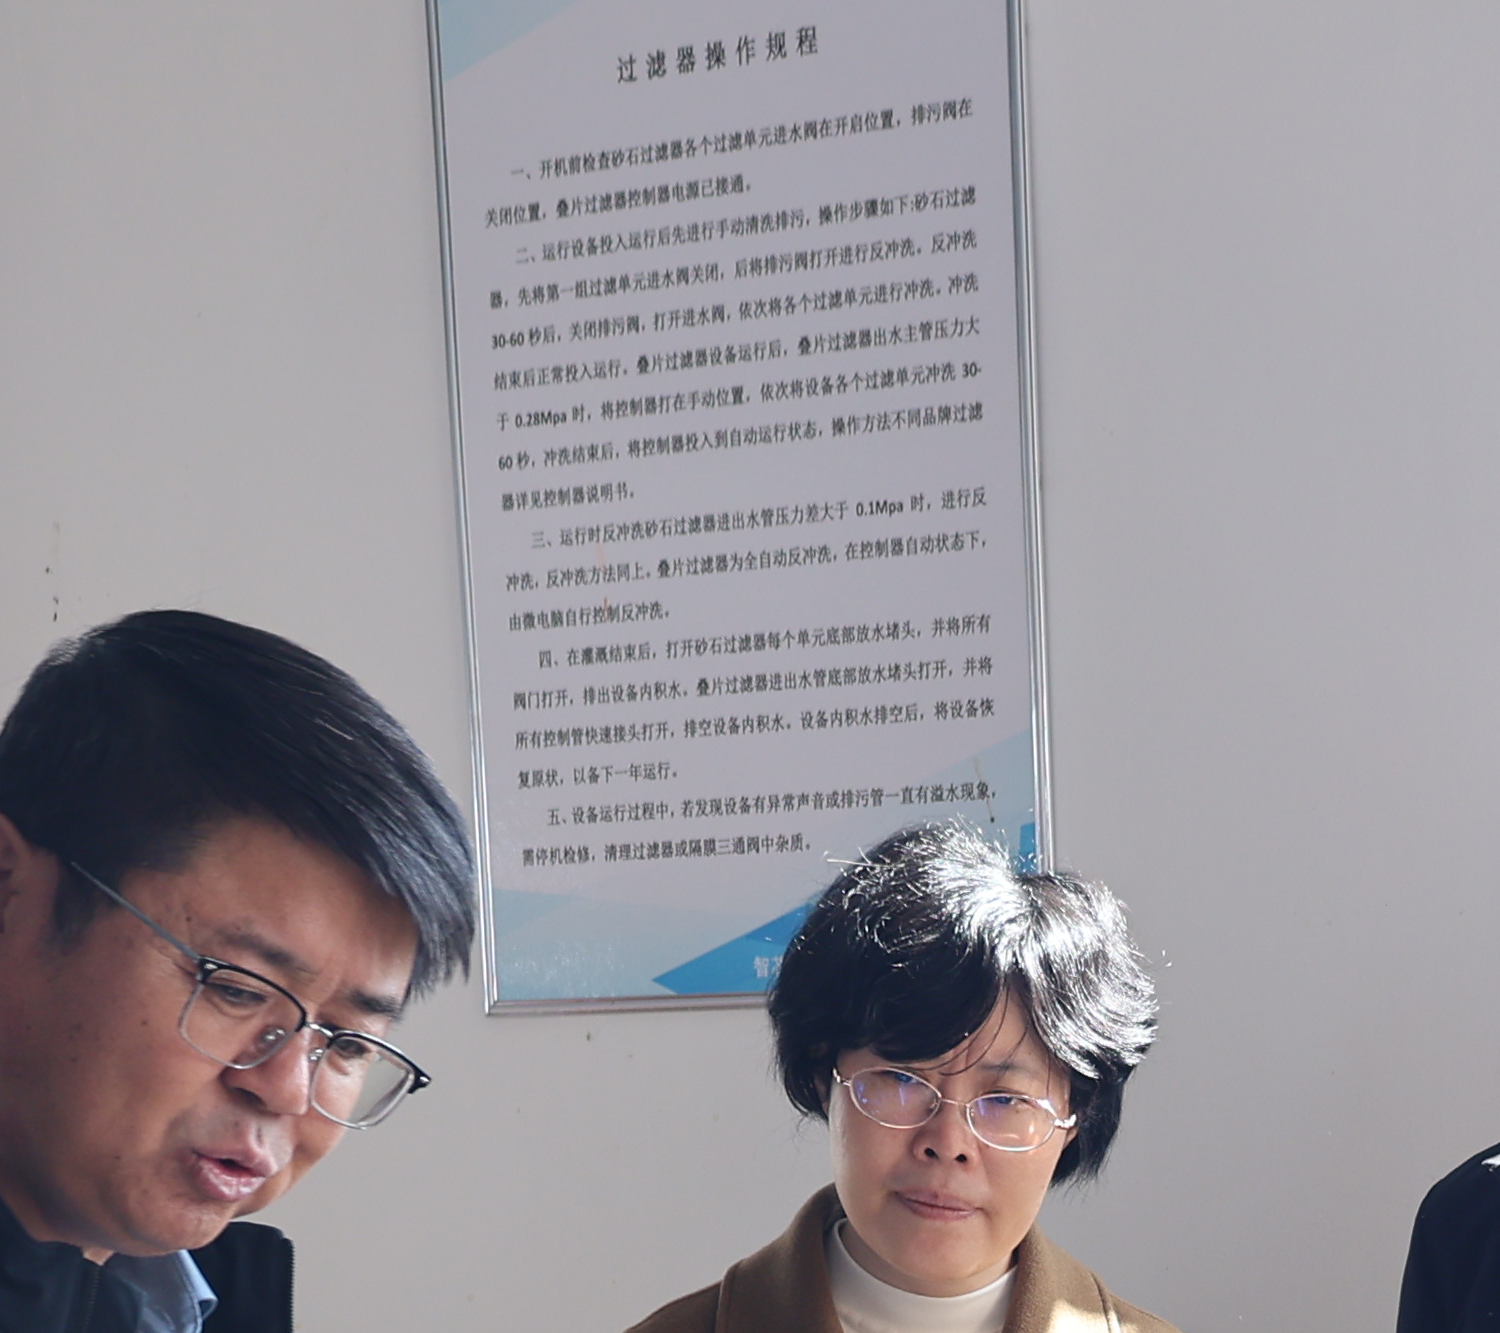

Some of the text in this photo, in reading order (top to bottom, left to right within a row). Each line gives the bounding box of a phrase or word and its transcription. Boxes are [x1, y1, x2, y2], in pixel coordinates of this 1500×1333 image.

[617, 25, 818, 84] 过滤器操作规程
[491, 331, 525, 350] 30-60
[497, 412, 509, 432] 于
[514, 409, 568, 429] 0.28Mpa
[962, 361, 982, 379] 30-
[498, 455, 514, 471] 60
[855, 499, 904, 518] 0.1Mpa
[910, 485, 987, 513] 时，进行反
